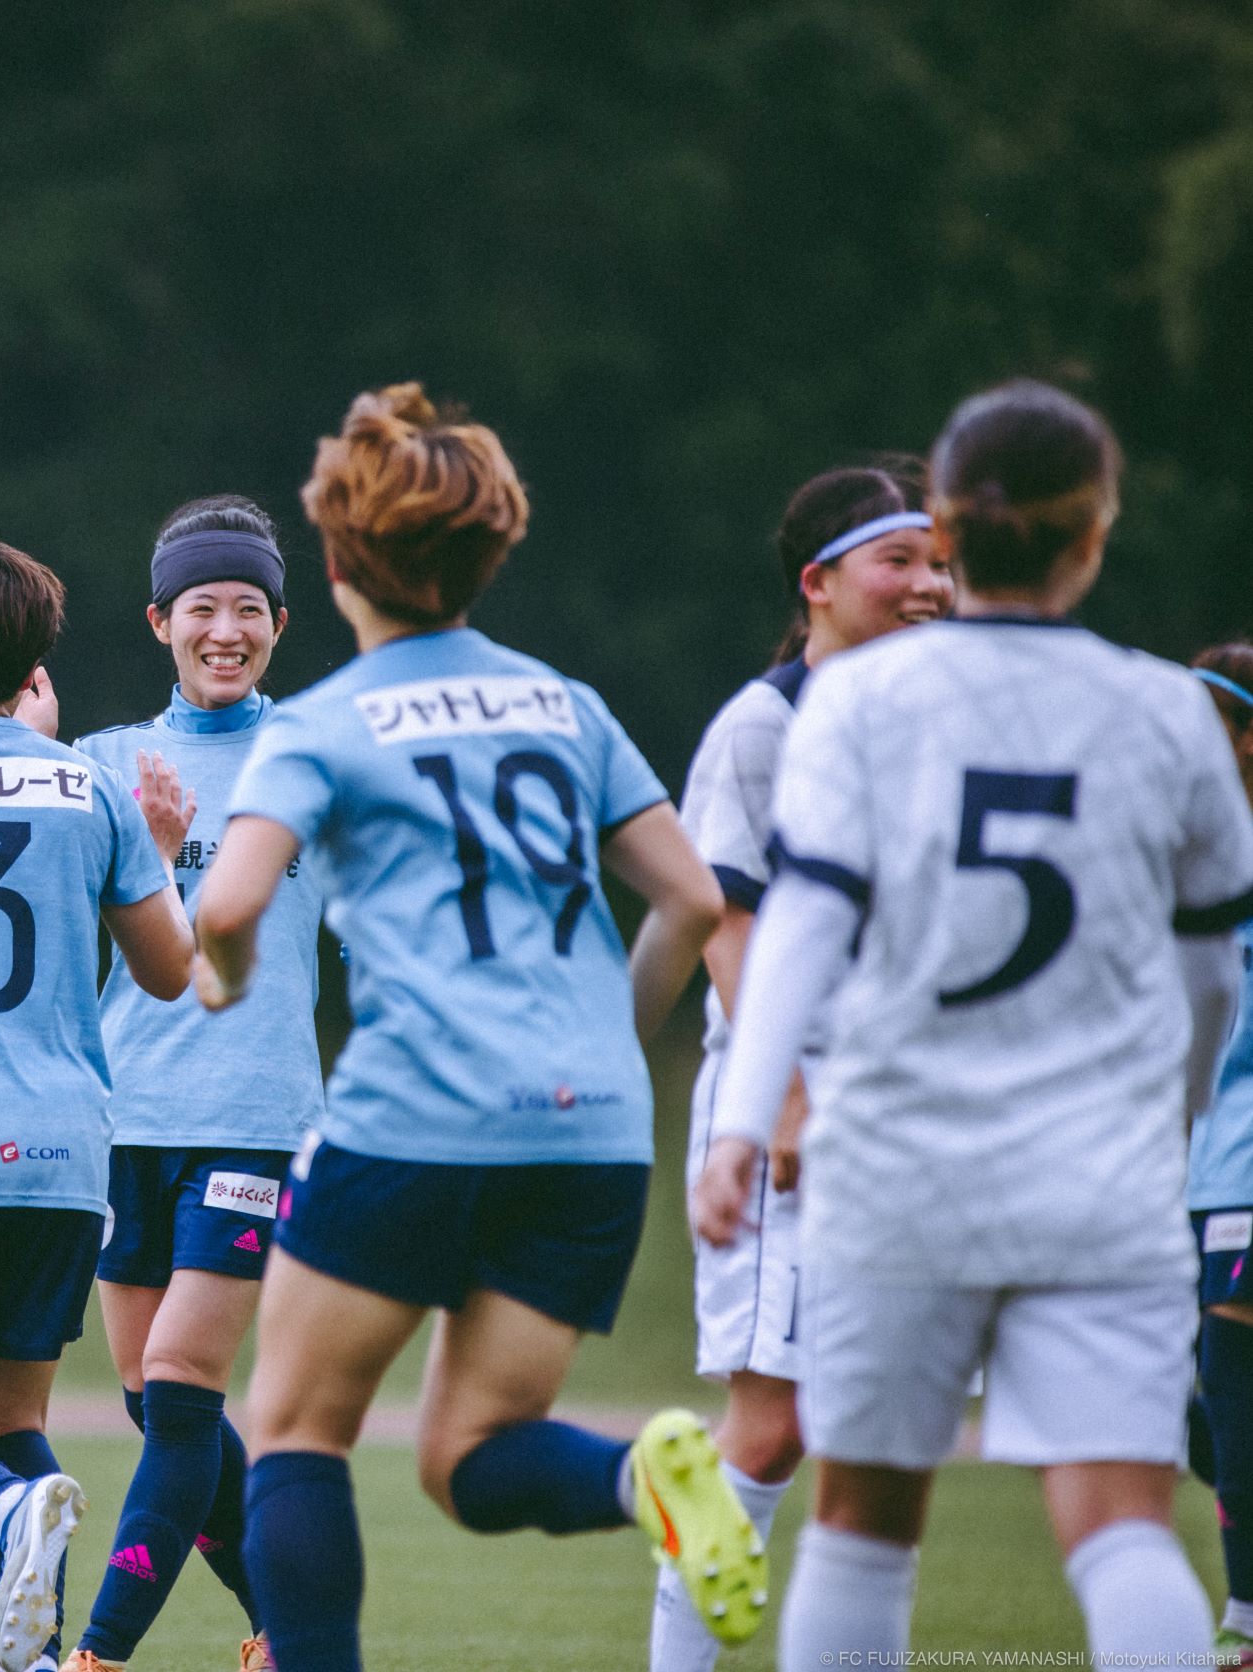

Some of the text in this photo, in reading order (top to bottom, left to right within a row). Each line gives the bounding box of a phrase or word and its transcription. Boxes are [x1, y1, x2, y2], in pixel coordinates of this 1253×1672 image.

[412, 752, 592, 963] 19
[937, 768, 1079, 1011] 5
[230, 1186, 275, 1206] はくばく
[233, 1239, 262, 1253] adidas
[109, 1555, 158, 1584] adidas
